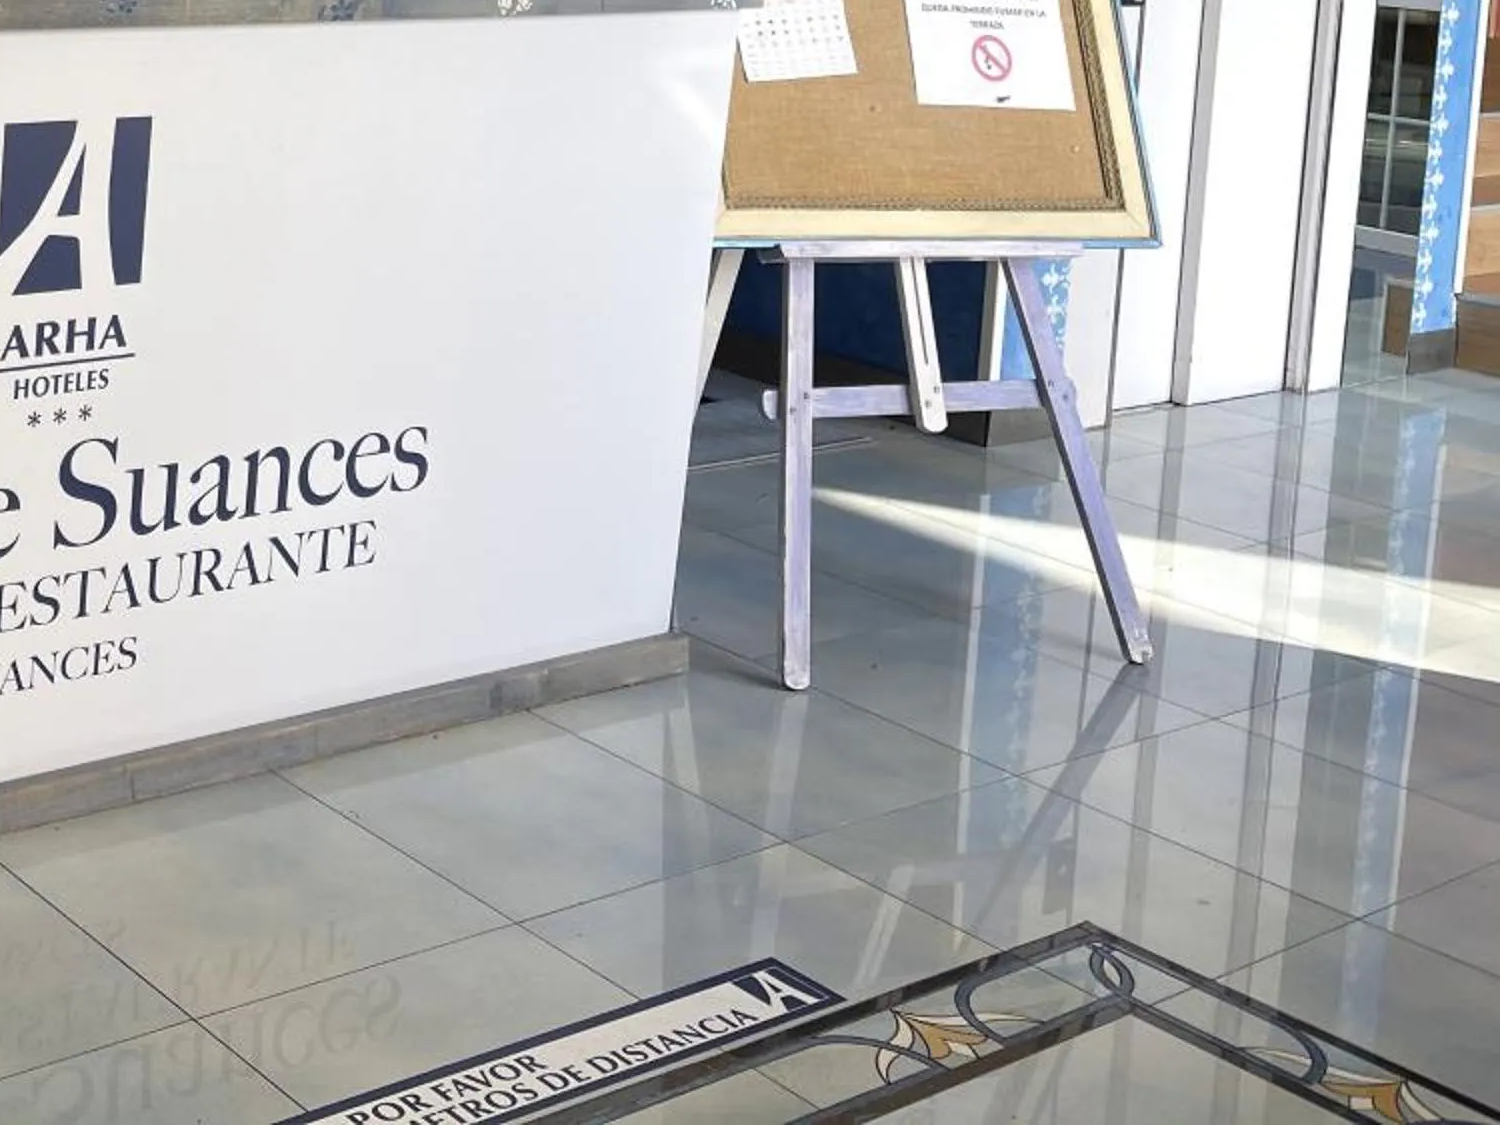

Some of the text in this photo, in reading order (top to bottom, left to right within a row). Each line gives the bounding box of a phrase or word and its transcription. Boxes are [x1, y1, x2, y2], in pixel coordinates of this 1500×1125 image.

[0, 314, 127, 361] ARHA
[13, 368, 109, 400] HOTELES
[52, 423, 430, 550] Suances
[346, 1054, 547, 1125] POR FAVOR
[408, 1007, 759, 1125] ETROS DE DISTANCIA
